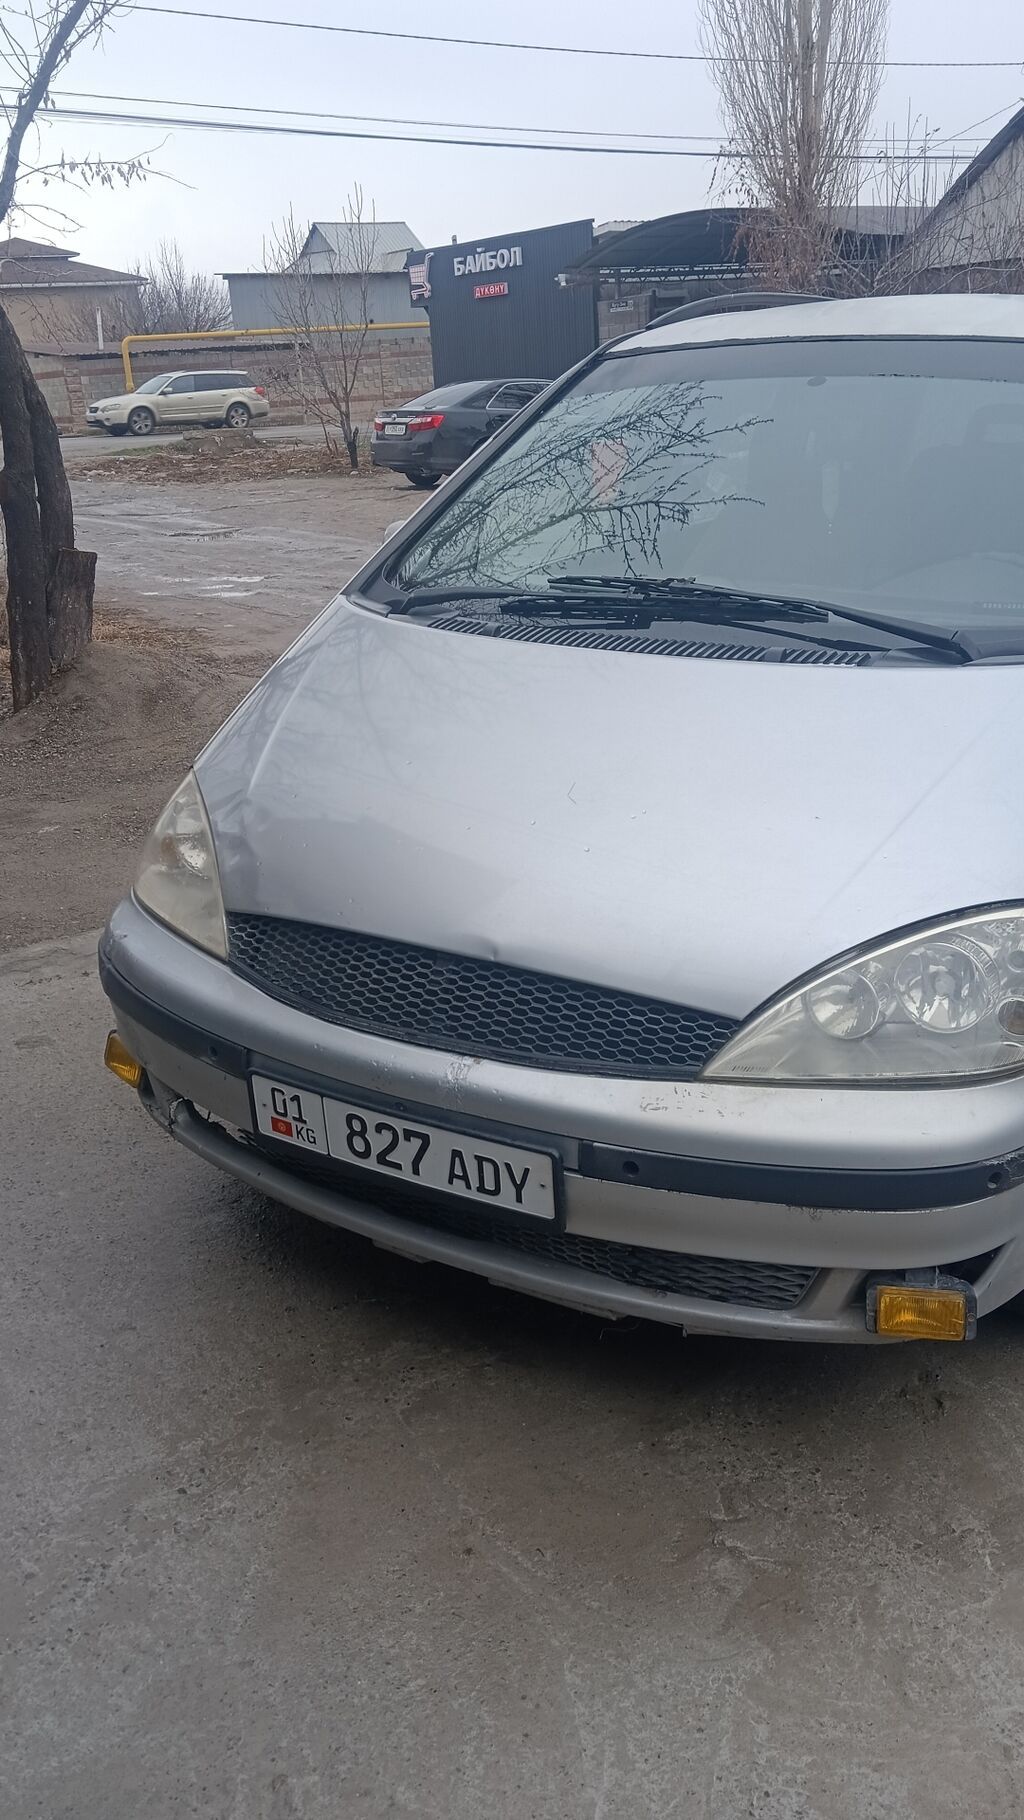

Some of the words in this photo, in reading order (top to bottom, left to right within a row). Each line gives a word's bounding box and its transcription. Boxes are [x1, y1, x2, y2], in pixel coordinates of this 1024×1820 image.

[453, 247, 523, 276] БАЙБОЛ
[270, 1086, 307, 1125] 01
[295, 1124, 317, 1146] KG
[345, 1112, 431, 1176] 827
[448, 1148, 530, 1204] ADY
